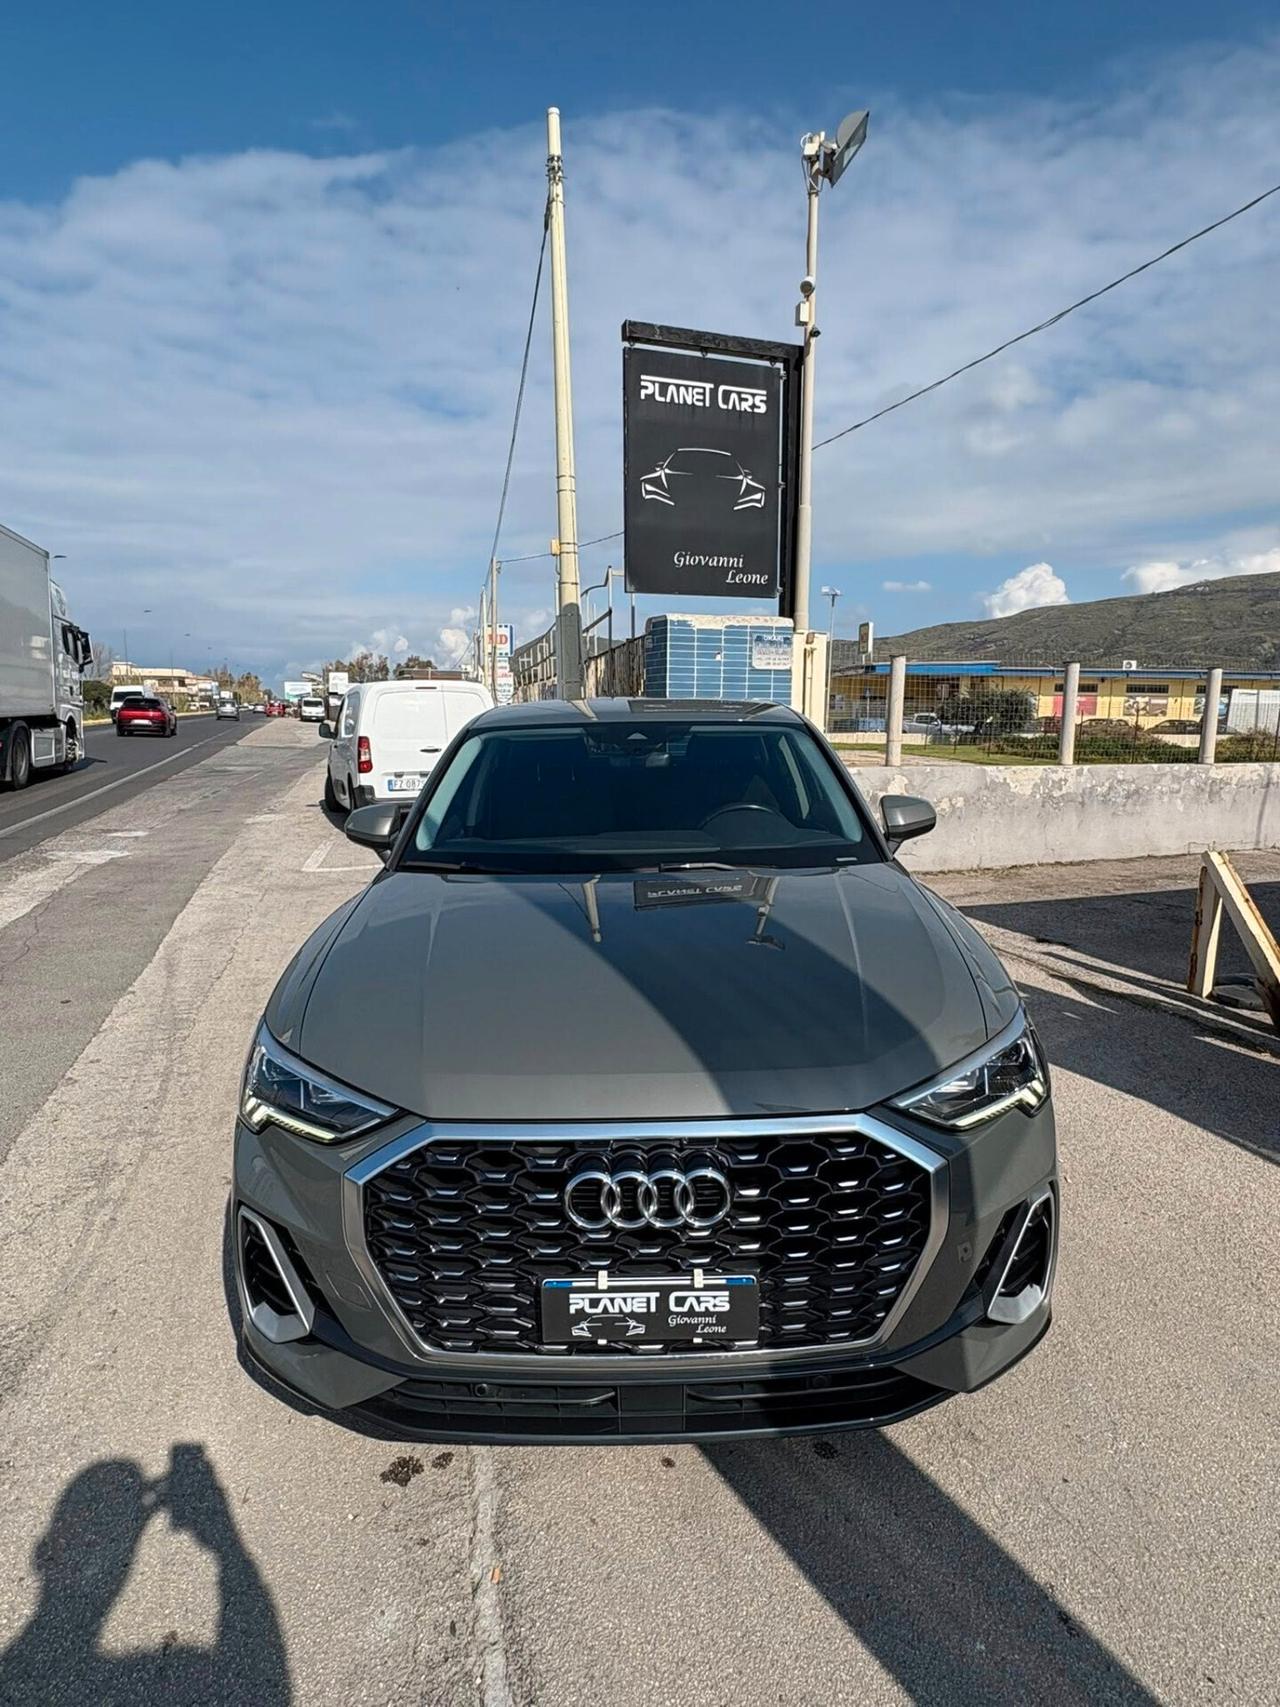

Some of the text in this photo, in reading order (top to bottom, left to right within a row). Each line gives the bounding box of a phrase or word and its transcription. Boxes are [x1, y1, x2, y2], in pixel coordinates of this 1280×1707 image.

[640, 374, 768, 414] PLANET CARS
[673, 551, 744, 569] Giovanni
[725, 570, 769, 586] Leone
[569, 1291, 731, 1314] PLANET CARS
[668, 1314, 717, 1327] Giovanni
[695, 1323, 727, 1334] Leone
